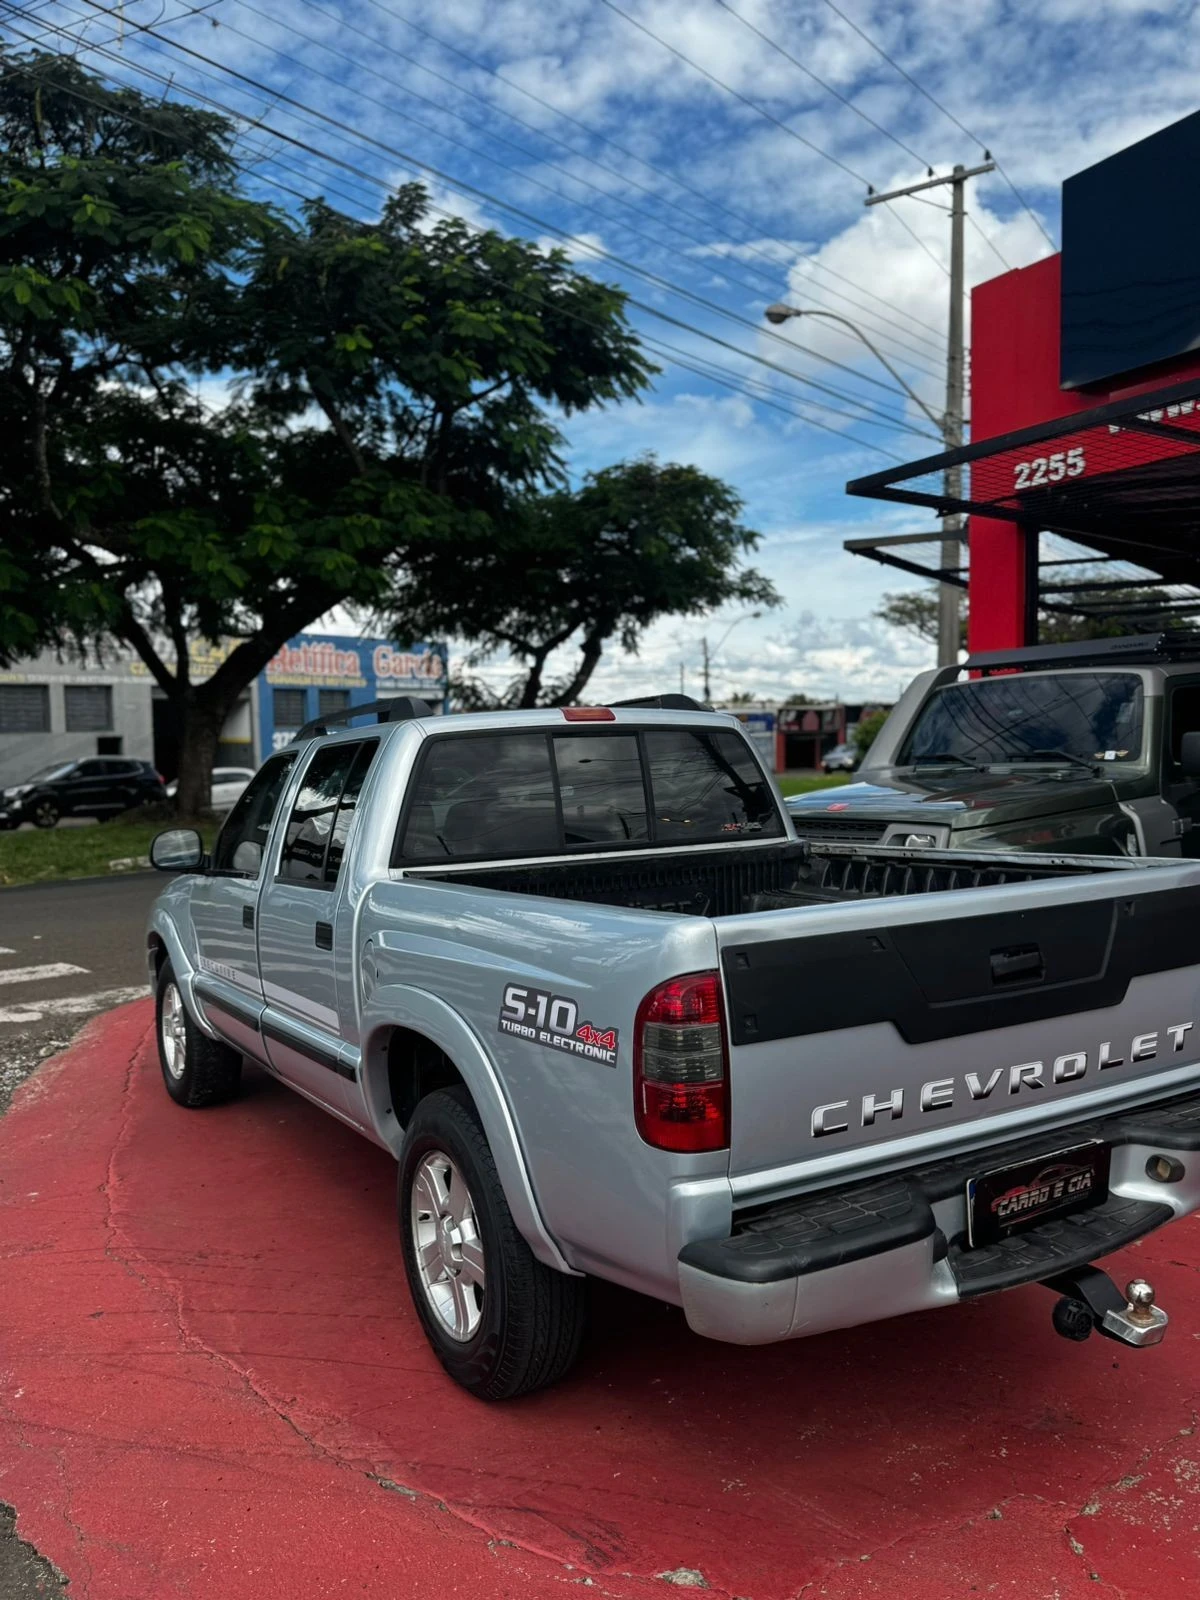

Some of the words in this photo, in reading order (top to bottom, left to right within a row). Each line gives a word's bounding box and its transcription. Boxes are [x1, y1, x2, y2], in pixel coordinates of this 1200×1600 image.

[1013, 446, 1086, 490] 2255
[501, 986, 577, 1036] S-10
[576, 1024, 615, 1050] 4x4
[501, 1019, 536, 1039] TURBO
[539, 1031, 616, 1063] ELECTRONIC
[811, 1021, 1194, 1138] CHEVROLET
[997, 1186, 1050, 1216] CARRO
[1067, 1171, 1091, 1193] CIA
